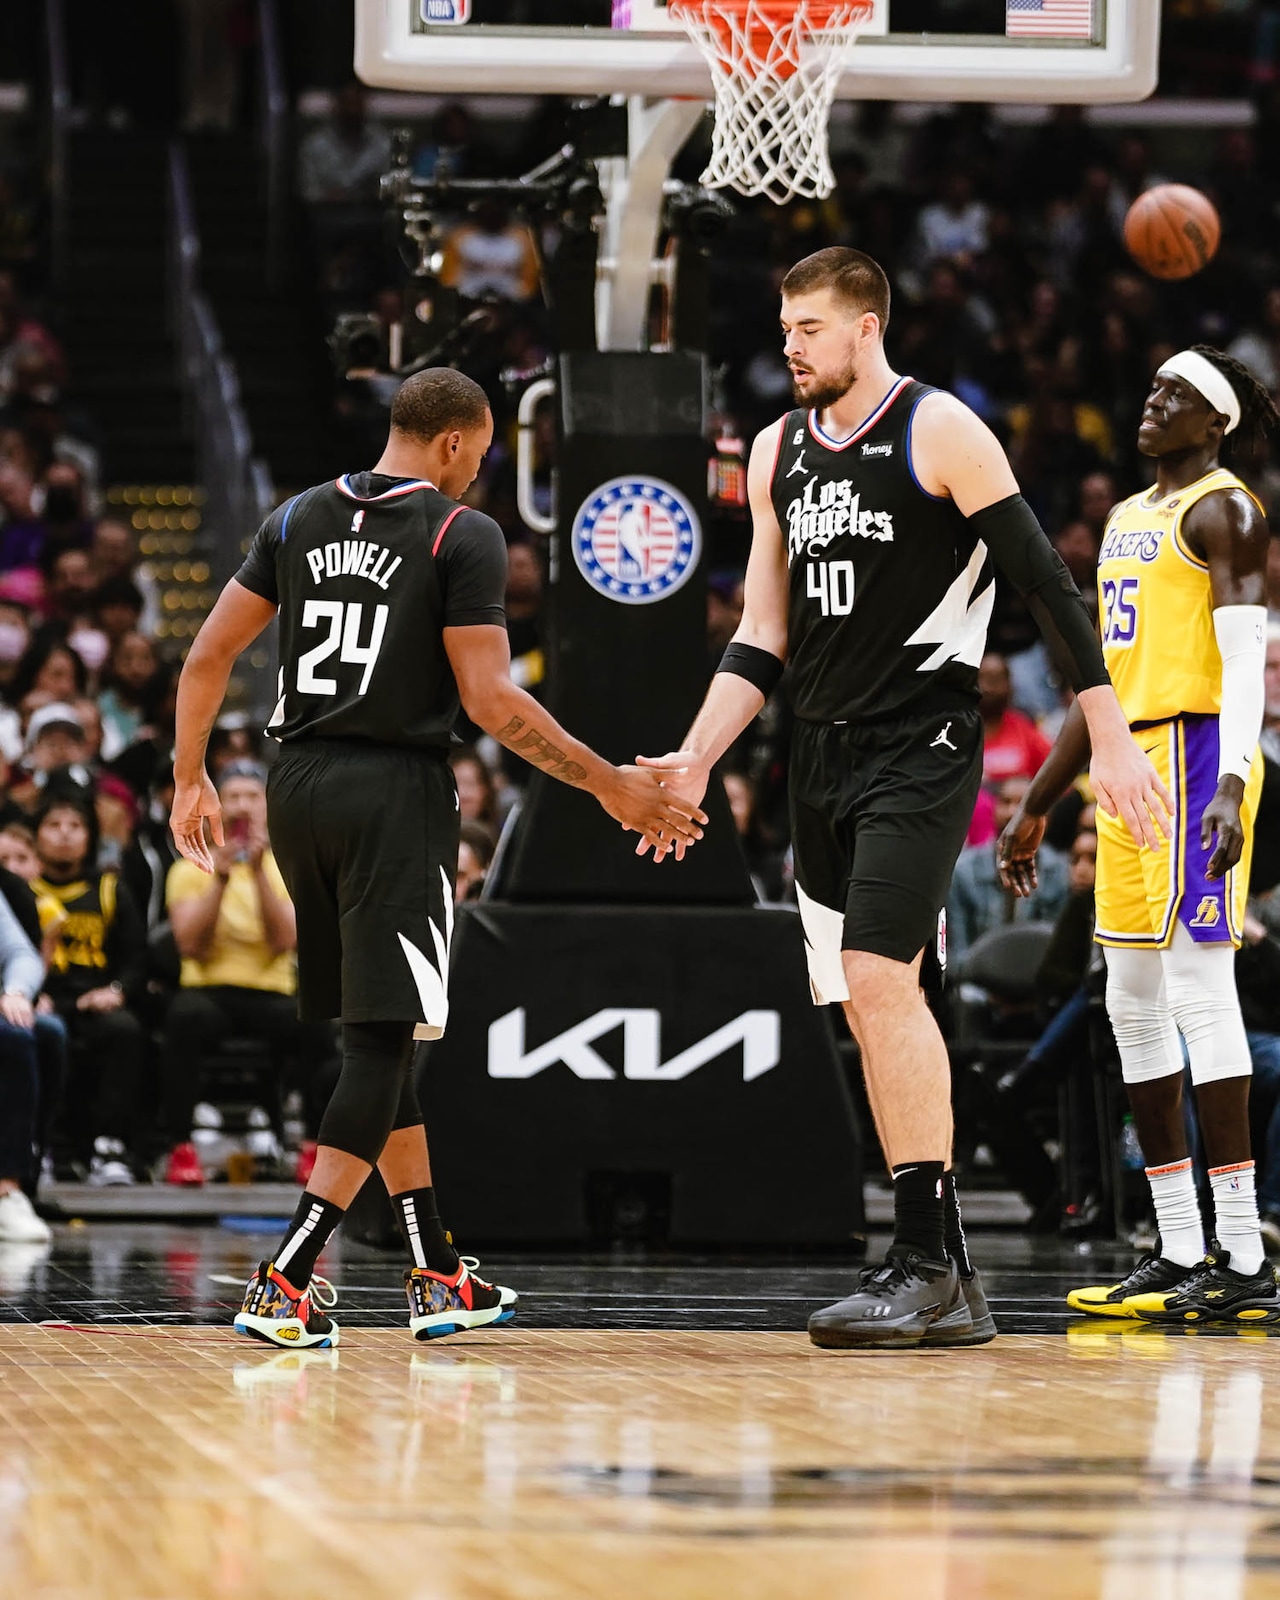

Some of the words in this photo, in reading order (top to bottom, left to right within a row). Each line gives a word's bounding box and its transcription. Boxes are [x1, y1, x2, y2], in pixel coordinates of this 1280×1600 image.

[792, 428, 804, 445] 6
[861, 443, 893, 457] honey
[803, 475, 853, 512] Los
[786, 493, 894, 566] Angeles
[306, 541, 402, 590] POWELL
[807, 561, 855, 616] 40
[1101, 579, 1138, 642] 35
[297, 600, 389, 696] 24
